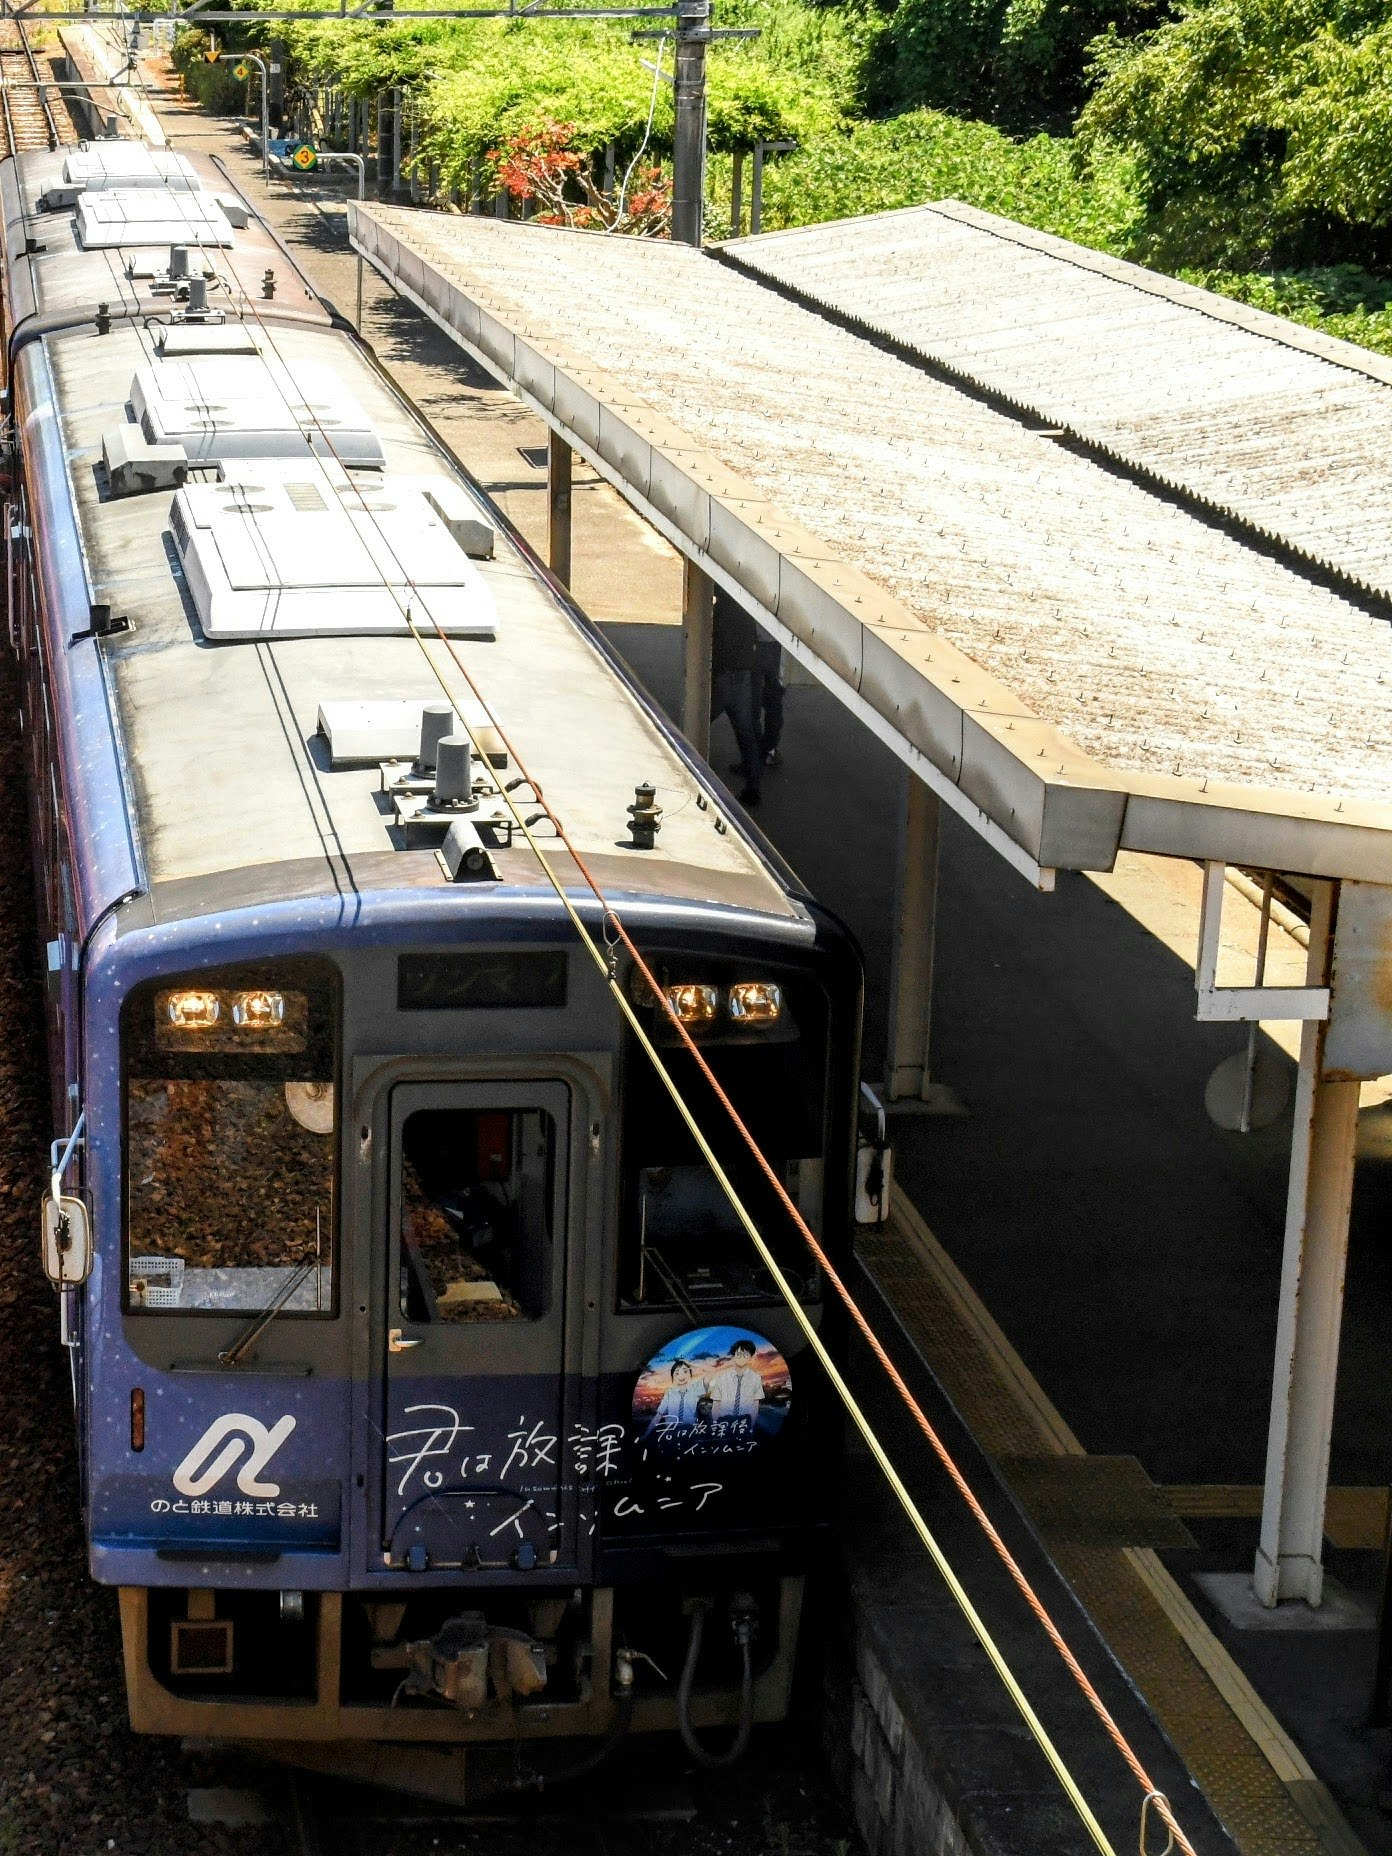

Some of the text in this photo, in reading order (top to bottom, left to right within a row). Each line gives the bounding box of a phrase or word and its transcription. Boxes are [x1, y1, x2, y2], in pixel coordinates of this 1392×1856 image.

[237, 68, 244, 76] 4
[300, 151, 309, 164] 3
[386, 1404, 649, 1496] 君は放課
[150, 1499, 319, 1518] のと鉄道株式会社
